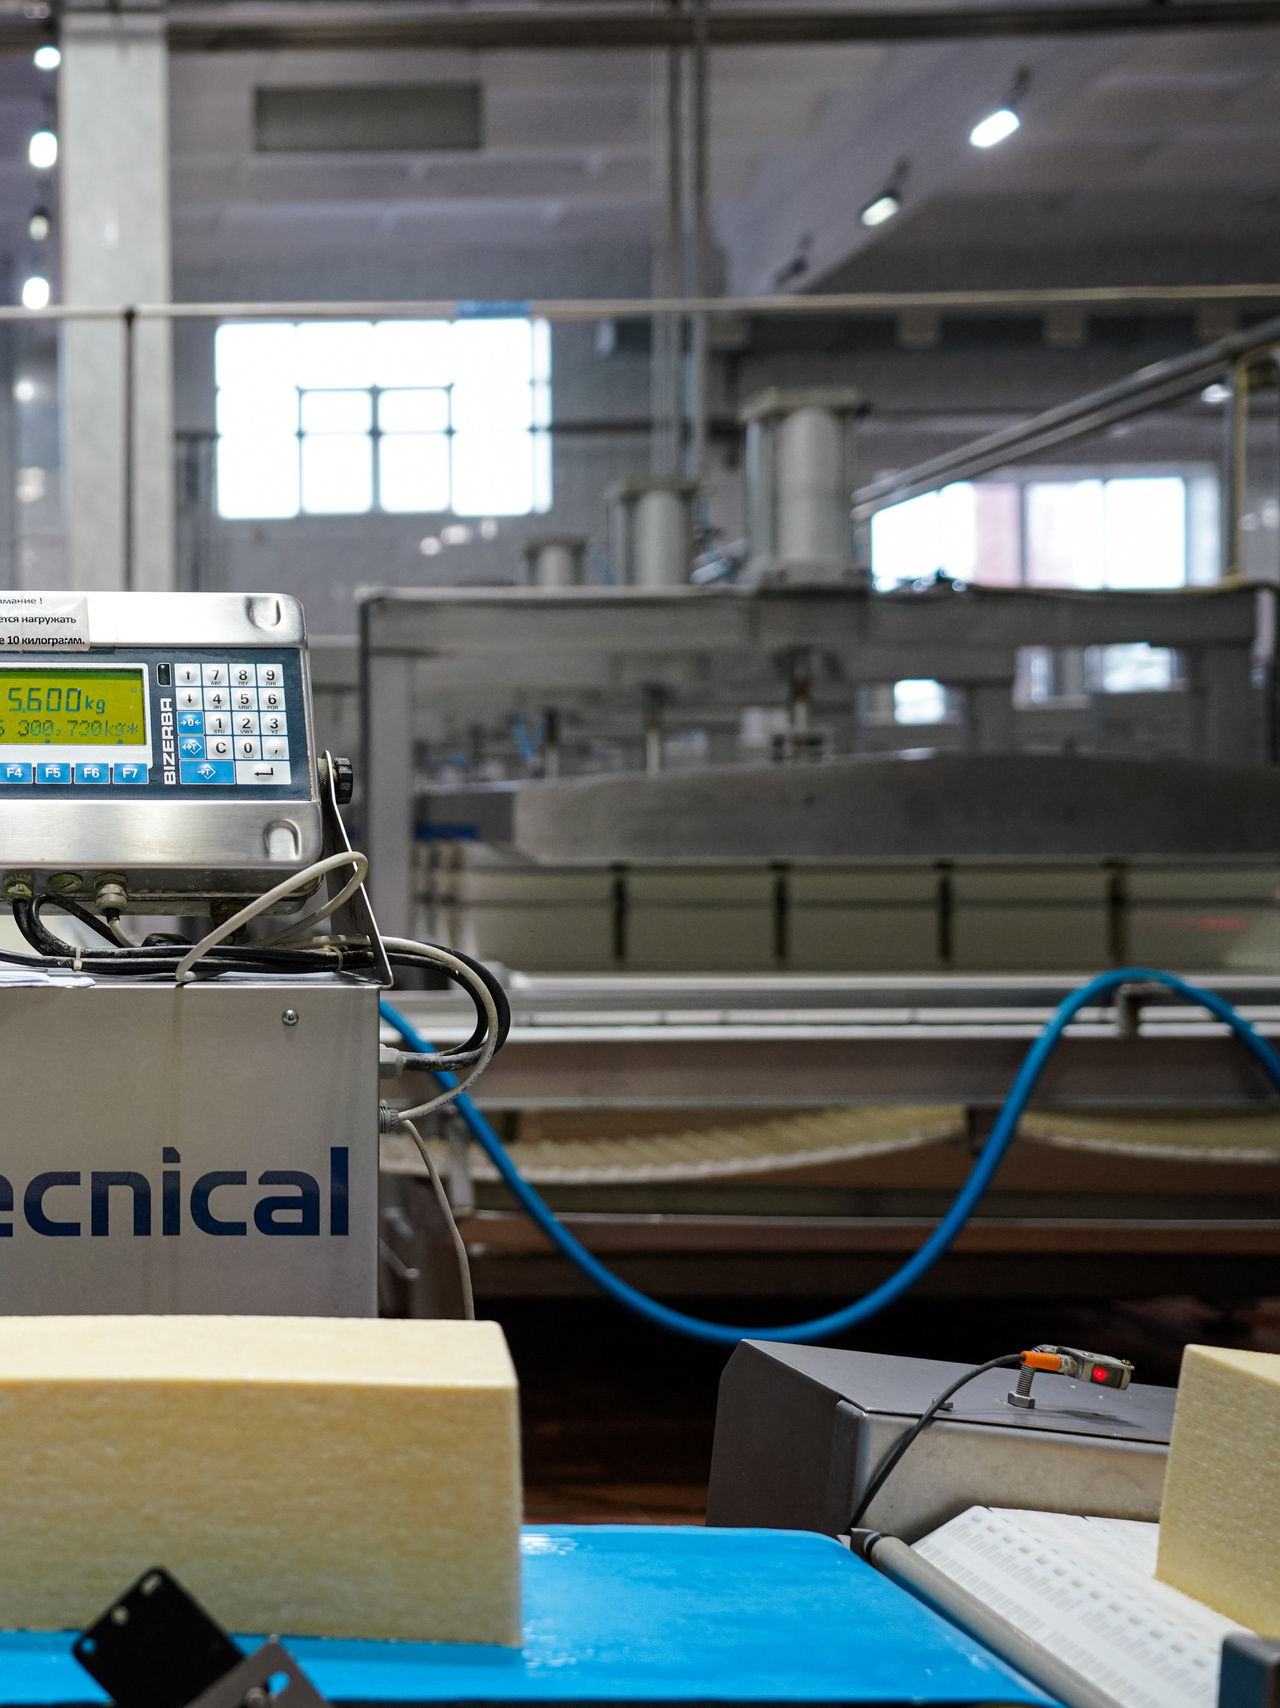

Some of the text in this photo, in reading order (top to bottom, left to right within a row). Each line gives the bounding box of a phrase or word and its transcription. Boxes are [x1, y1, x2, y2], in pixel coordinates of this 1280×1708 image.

[21, 616, 77, 625] нагружать
[7, 635, 20, 645] 10
[21, 636, 86, 647] килограмм.
[211, 669, 220, 681] 7
[238, 669, 248, 681] 8
[266, 669, 275, 681] 9
[85, 695, 106, 714] kg
[212, 693, 222, 705] 4
[240, 693, 249, 705] 5
[267, 693, 277, 705] 6
[215, 717, 222, 729] 1
[242, 717, 251, 729] 2
[269, 717, 279, 729] 3
[160, 697, 177, 785] BIZERBA
[215, 742, 227, 754] C
[243, 742, 253, 754] 0
[6, 767, 23, 778] F4
[45, 767, 61, 778] F5
[83, 767, 100, 778] F6
[122, 767, 138, 778] F7
